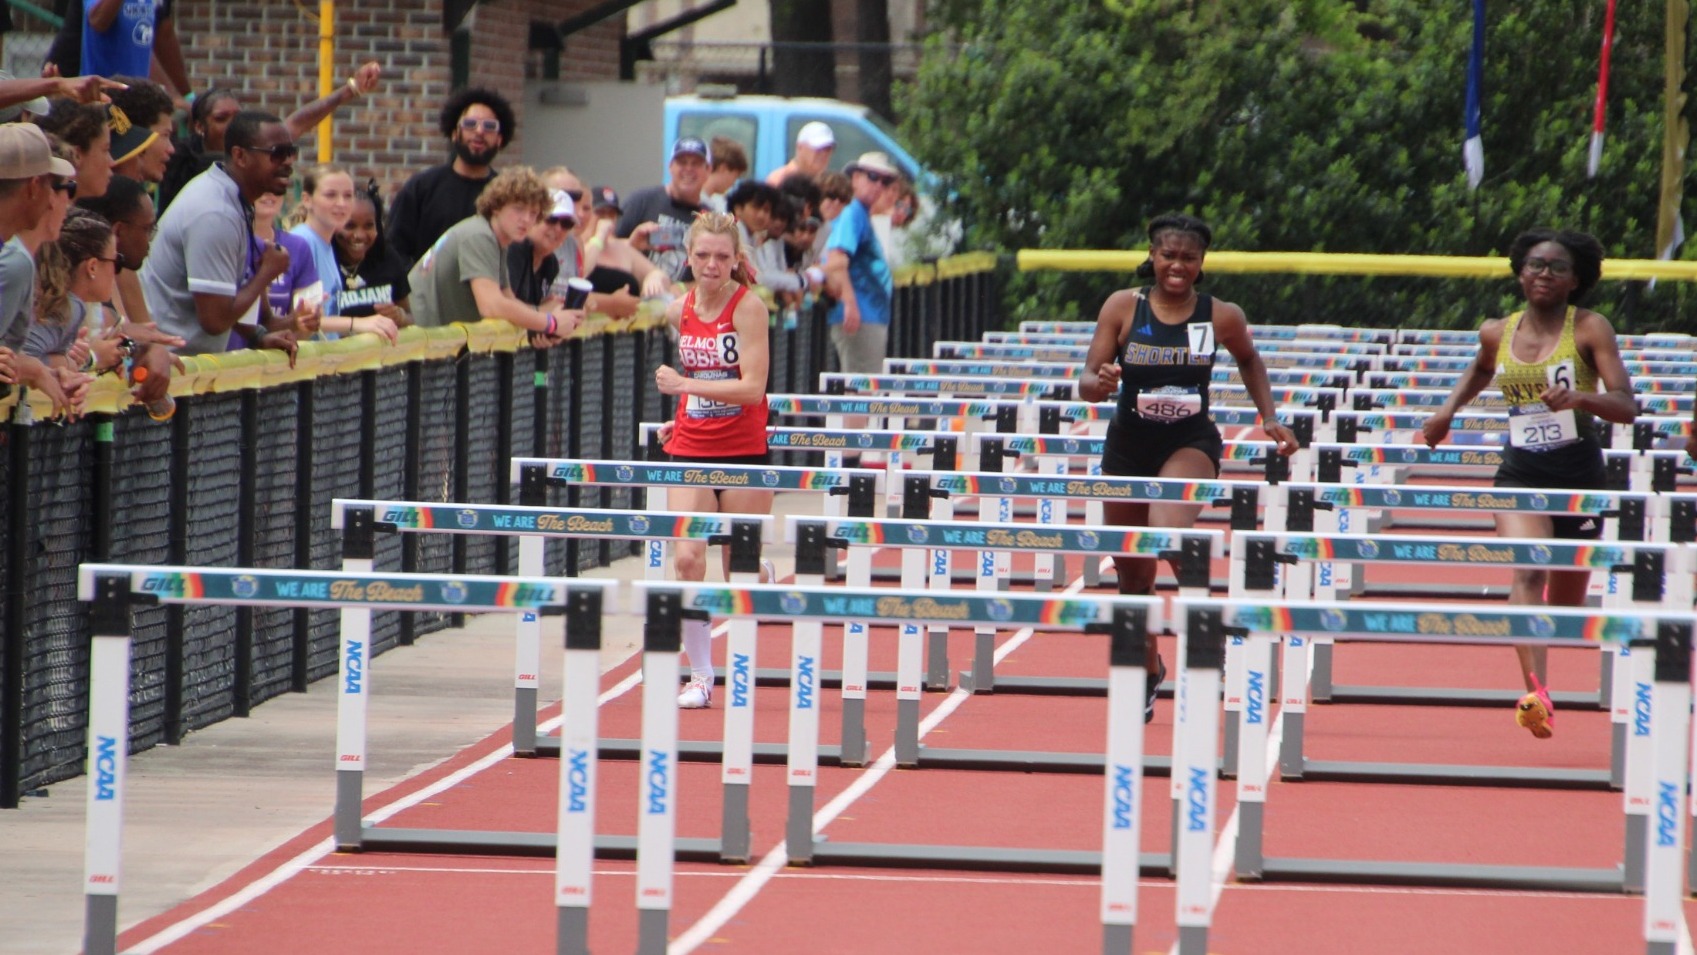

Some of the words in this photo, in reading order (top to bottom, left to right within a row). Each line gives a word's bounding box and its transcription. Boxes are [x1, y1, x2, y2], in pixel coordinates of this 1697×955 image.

[1193, 325, 1208, 353] 7
[722, 335, 739, 364] 8
[1145, 403, 1192, 417] 486
[773, 435, 788, 446] ARE
[789, 433, 811, 449] The
[811, 434, 846, 450] Beach
[1524, 424, 1562, 444] 213
[1009, 440, 1037, 451] GILL
[1233, 445, 1260, 456] GILL
[1346, 451, 1375, 461] GILL
[1428, 452, 1442, 463] WE
[1444, 453, 1459, 464] ARE
[1461, 451, 1482, 465] The
[553, 467, 585, 478] GILL
[646, 470, 662, 483] WE
[664, 471, 682, 485] ARE
[684, 470, 708, 486] The
[709, 470, 748, 488] Beach
[811, 475, 842, 486] GILL
[936, 479, 967, 490] GILL
[1029, 482, 1045, 494] WE
[1047, 483, 1065, 496] ARE
[1067, 481, 1091, 497] The
[1092, 482, 1132, 498] Beach
[1194, 486, 1225, 498] GILL
[1320, 491, 1350, 502] GILL
[1413, 493, 1430, 506] WE
[1432, 494, 1449, 507] ARE
[1451, 492, 1475, 508] The
[1476, 493, 1516, 510] Beach
[383, 511, 419, 523] GILL
[493, 515, 513, 529] WE
[514, 516, 536, 530] ARE
[537, 514, 565, 531] The
[566, 515, 614, 533] Beach
[688, 521, 723, 534] GILL
[834, 527, 869, 539] GILL
[943, 530, 963, 544] WE
[965, 531, 985, 545] ARE
[986, 529, 1015, 546] The
[1015, 530, 1063, 548] Beach
[1137, 535, 1172, 549] GILL
[649, 541, 662, 568] CAA
[935, 550, 947, 575] CAA
[1393, 545, 1414, 559] WE
[1416, 546, 1437, 560] ARE
[1437, 544, 1466, 561] The
[1467, 545, 1515, 563] Beach
[981, 552, 993, 577] CAA
[1320, 562, 1331, 586] CAA
[141, 577, 186, 593] GILL
[276, 581, 299, 597] WE
[301, 583, 326, 599] ARE
[328, 580, 366, 601] The
[365, 581, 424, 604] Beach
[514, 588, 554, 603] GILL
[823, 598, 848, 614] WE
[850, 599, 874, 615] ARE
[875, 596, 912, 619] The
[913, 597, 970, 620] Beach
[1363, 613, 1388, 631] WE
[1390, 614, 1417, 632] ARE
[1417, 612, 1453, 635] The
[1453, 613, 1512, 637] Beach
[345, 640, 363, 694] NCAA
[732, 653, 750, 708] NCAA
[797, 655, 814, 709] NCAA
[1247, 670, 1264, 725] NCAA
[1635, 682, 1653, 737] NCAA
[340, 754, 361, 762] GILL
[95, 736, 116, 801] NCAA
[568, 750, 588, 813] NCAA
[648, 751, 668, 815] NCAA
[1113, 765, 1133, 830] NCAA
[1188, 767, 1208, 832] NCAA
[1657, 781, 1679, 847] NCAA
[89, 875, 115, 884] GILL
